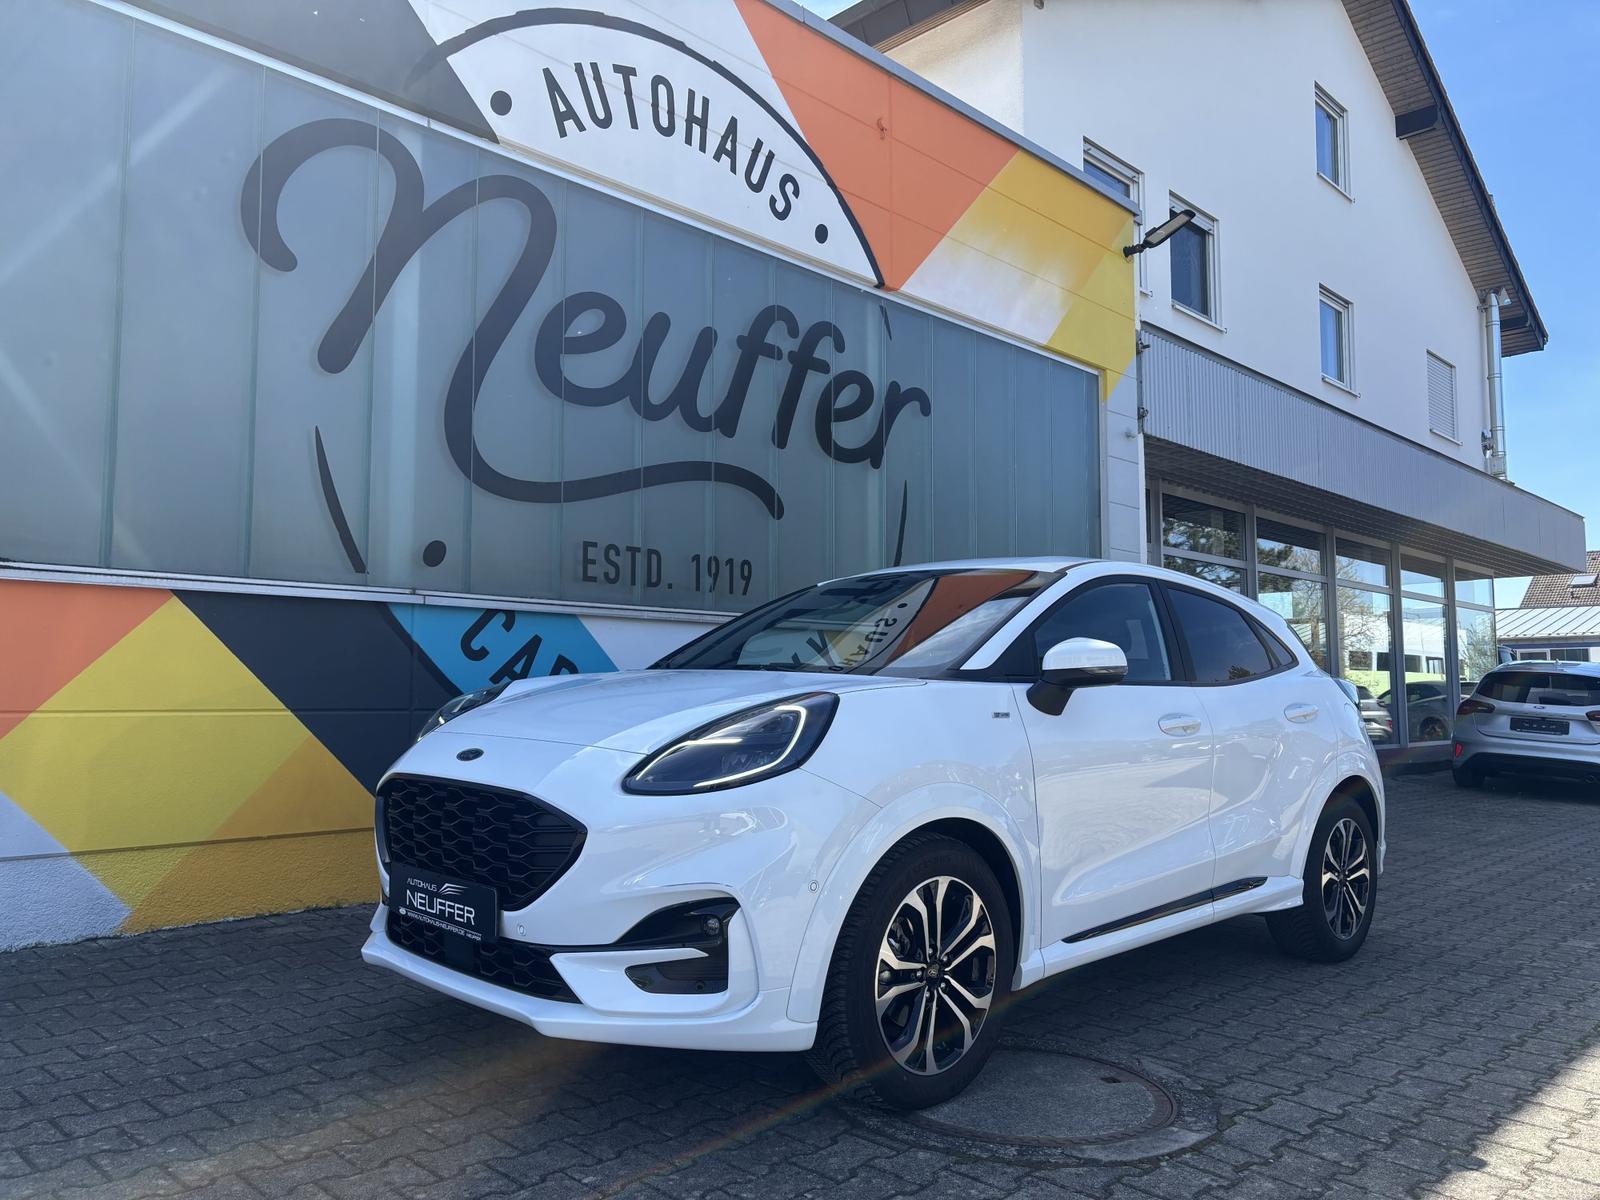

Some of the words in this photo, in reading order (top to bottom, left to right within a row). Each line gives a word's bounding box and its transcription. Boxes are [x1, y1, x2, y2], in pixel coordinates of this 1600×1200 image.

[542, 62, 800, 221] AUTOHAUS
[240, 117, 932, 521] Neuffer
[581, 540, 673, 589] ESTD.
[690, 553, 753, 596] 1919
[406, 889, 475, 925] NEUFFER
[407, 877, 437, 891] AUTOHAUS
